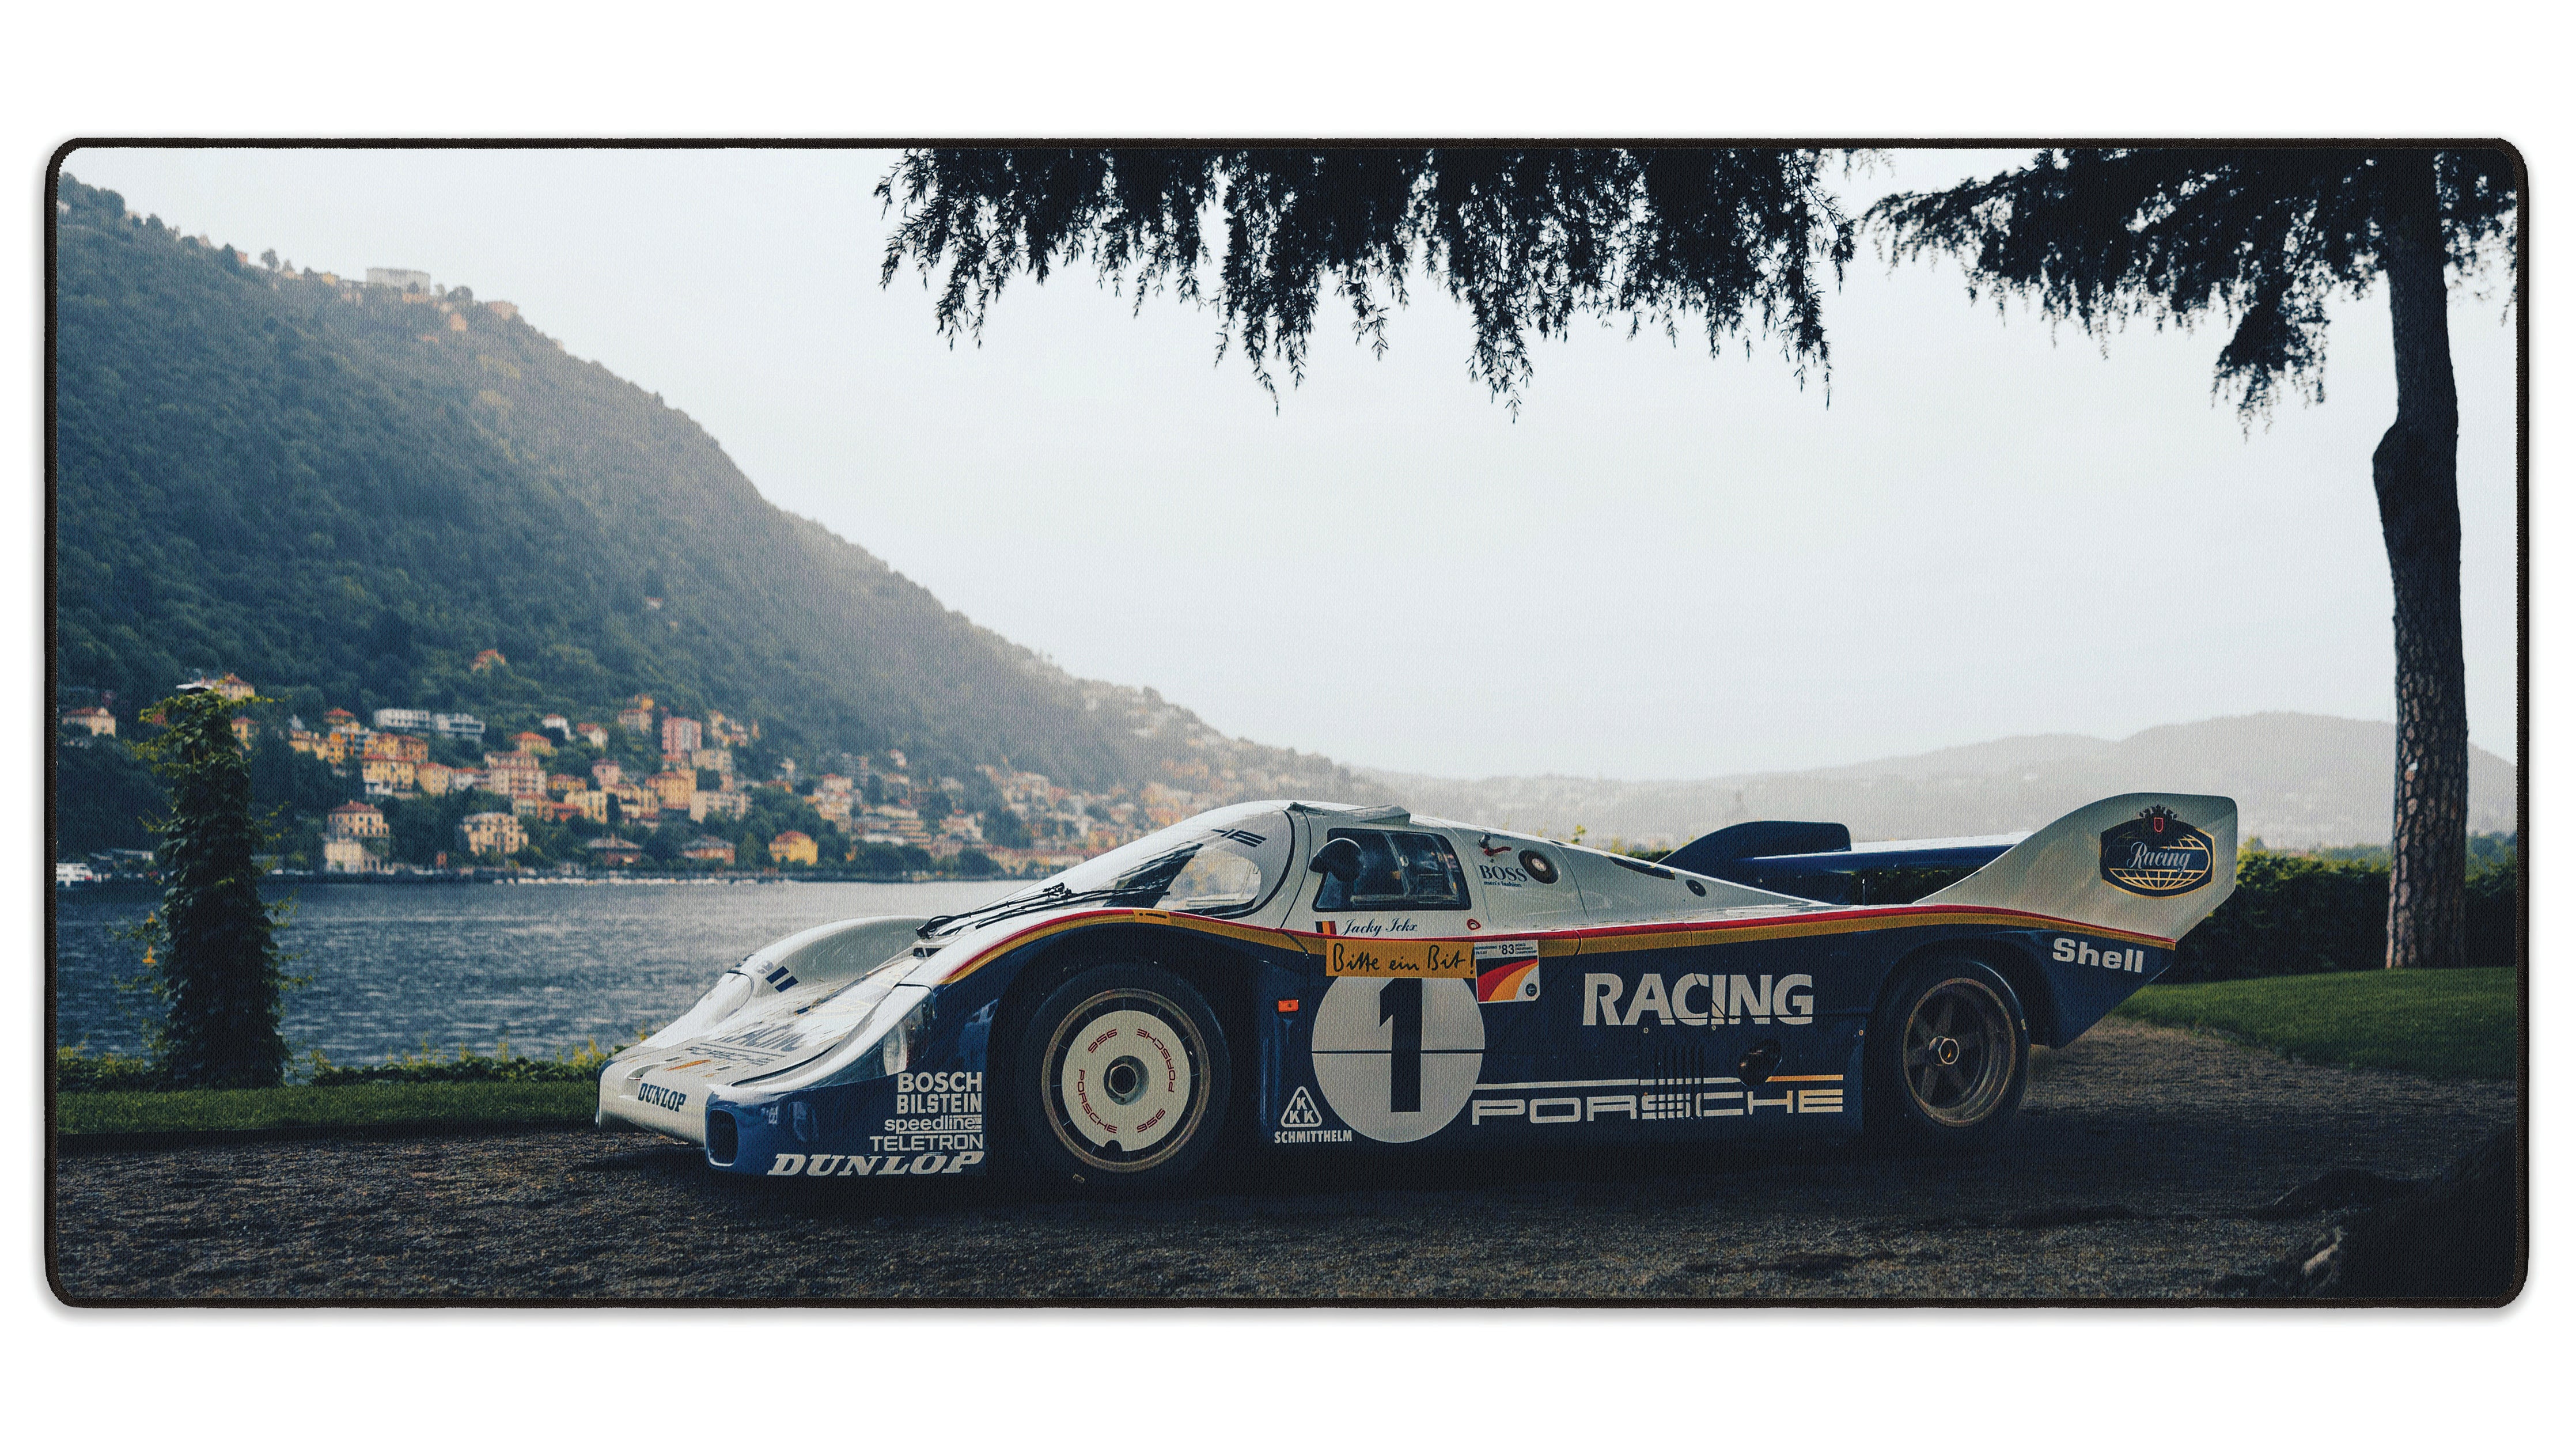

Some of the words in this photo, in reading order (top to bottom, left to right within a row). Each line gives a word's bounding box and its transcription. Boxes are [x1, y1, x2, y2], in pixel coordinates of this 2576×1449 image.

[2127, 841, 2191, 873] Racing
[1479, 864, 1528, 882] BOSS
[1341, 918, 1382, 937] Jacky
[1385, 918, 1418, 932] Ickx
[1333, 942, 1380, 972] Bitte
[1389, 956, 1420, 971] ein
[1498, 944, 1514, 955] '83
[2053, 937, 2144, 973] Shell
[1582, 972, 1813, 1026] RACING
[1088, 1029, 1117, 1053] 956
[1380, 977, 1423, 1113] 1
[1137, 1028, 1176, 1093] PORSCHE
[897, 1071, 982, 1093] BOSCH
[638, 1083, 687, 1113] DUNLOP
[896, 1093, 982, 1114] BILSTEIN
[1077, 1069, 1117, 1133] PORSCHE
[1472, 1088, 1843, 1125] PORSCHE
[884, 1115, 978, 1134] speedline
[1137, 1108, 1166, 1133] 956
[869, 1134, 983, 1152] TELETRON
[1274, 1130, 1353, 1144] SCHMITTHELM
[767, 1151, 985, 1176] DUNLOP
